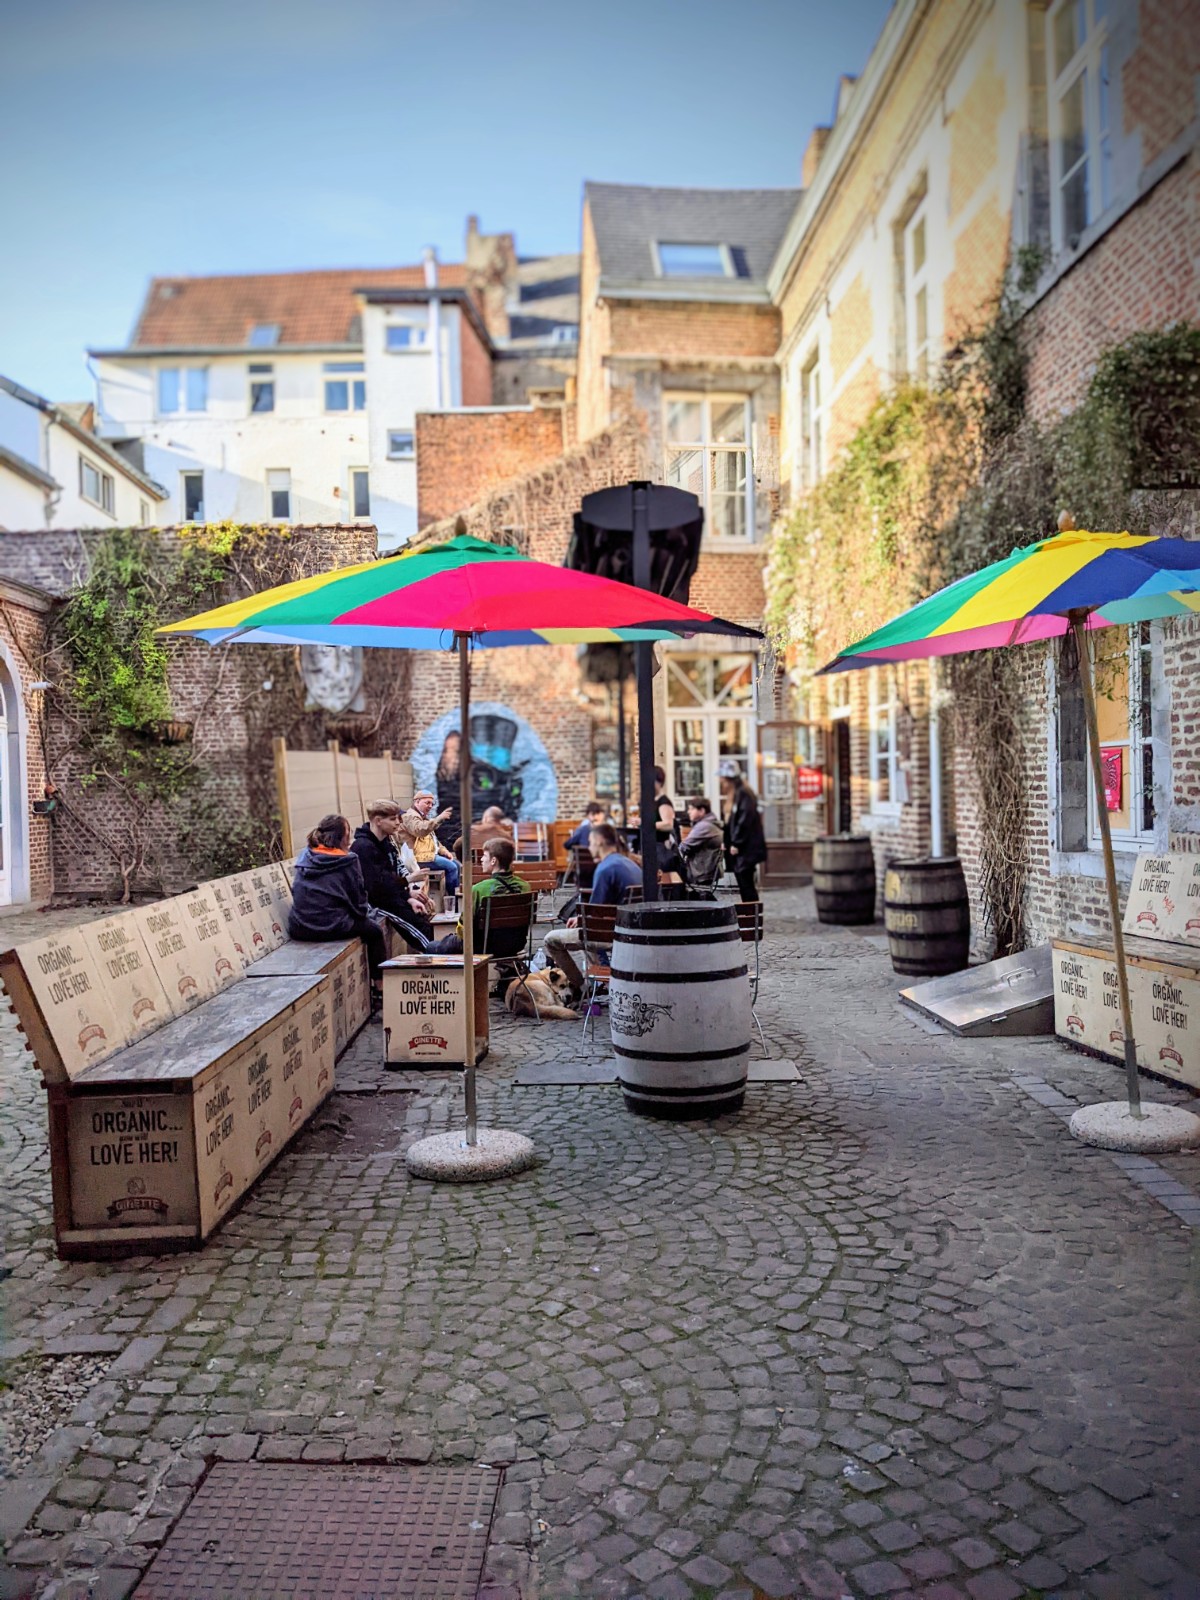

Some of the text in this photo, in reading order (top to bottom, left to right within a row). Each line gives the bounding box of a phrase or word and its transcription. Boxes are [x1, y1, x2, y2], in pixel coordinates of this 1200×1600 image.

[1144, 859, 1175, 875] ORGANIC...
[1139, 878, 1170, 894] LOVE HER!
[37, 945, 83, 975] ORGANIC...
[106, 950, 143, 979] LOVE HER!
[1061, 960, 1088, 980] ORGANIC...
[47, 979, 74, 1005] LOVE
[70, 971, 92, 997] HER!
[402, 980, 459, 994] ORGANIC...
[1060, 979, 1088, 1000] LOVE HER!
[1152, 983, 1189, 1007] ORGANIC...
[400, 1001, 455, 1015] LOVE HER!
[1103, 992, 1118, 1009] LOVE
[1152, 1005, 1169, 1025] LOVE
[1171, 1009, 1188, 1030] HER!
[92, 1110, 183, 1134] ORGANIC...
[206, 1124, 221, 1156] LOVE
[221, 1112, 235, 1141] HER!
[90, 1141, 178, 1166] LOVE HER!
